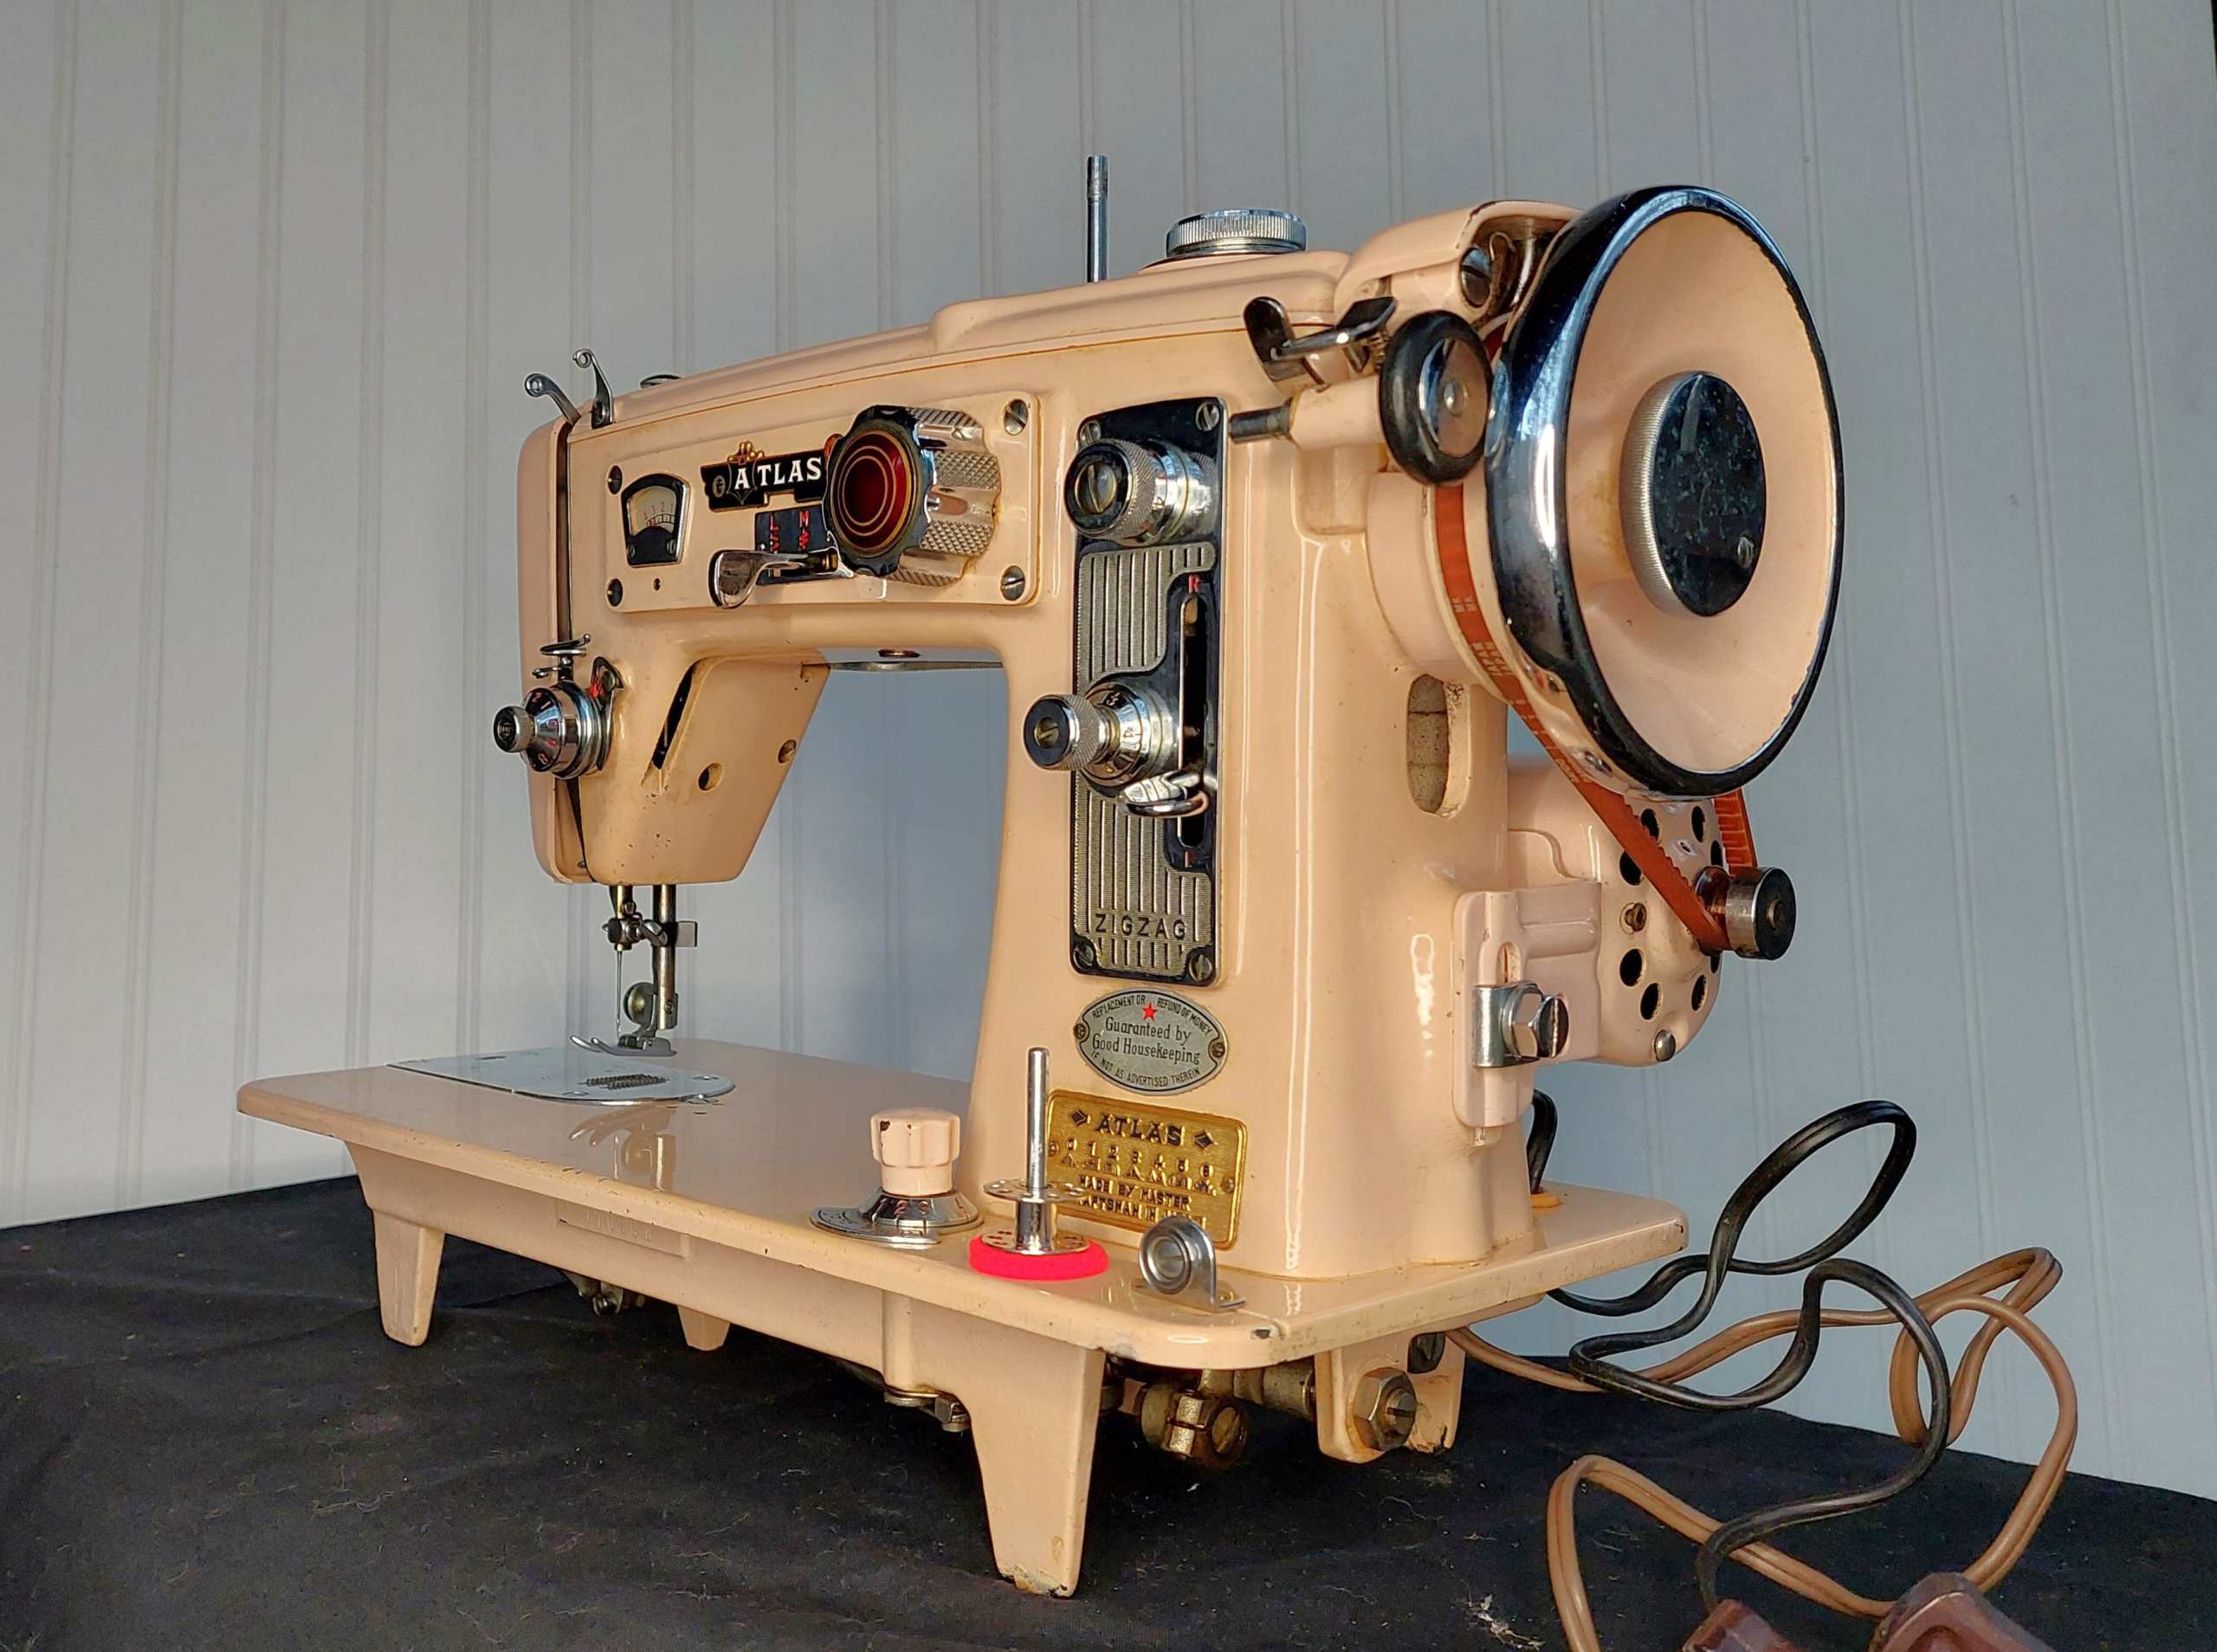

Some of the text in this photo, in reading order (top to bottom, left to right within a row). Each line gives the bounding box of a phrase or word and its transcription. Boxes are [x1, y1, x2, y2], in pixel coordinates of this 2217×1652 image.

[734, 456, 822, 490] ATLAS
[770, 511, 809, 531] L M
[1096, 913, 1186, 940] ZIGZAG
[1091, 995, 1213, 1036] REPLACEMENT OR REFUND OF MONEY
[1105, 1016, 1192, 1046] Guaranteed by
[1092, 1033, 1201, 1065] Good Housekeeping
[1090, 1050, 1201, 1087] IF NOT AS ADVERTISED THEREIN
[1096, 1113, 1186, 1146] ATLAS
[1066, 1137, 1077, 1151] 0
[1088, 1141, 1097, 1157] 1
[1108, 1146, 1120, 1161] 2
[1131, 1151, 1142, 1164] 3
[1154, 1154, 1166, 1169] 4
[894, 1200, 908, 1215] 2
[918, 1200, 929, 1215] 3
[1079, 1175, 1193, 1211] MADE BY MASTER
